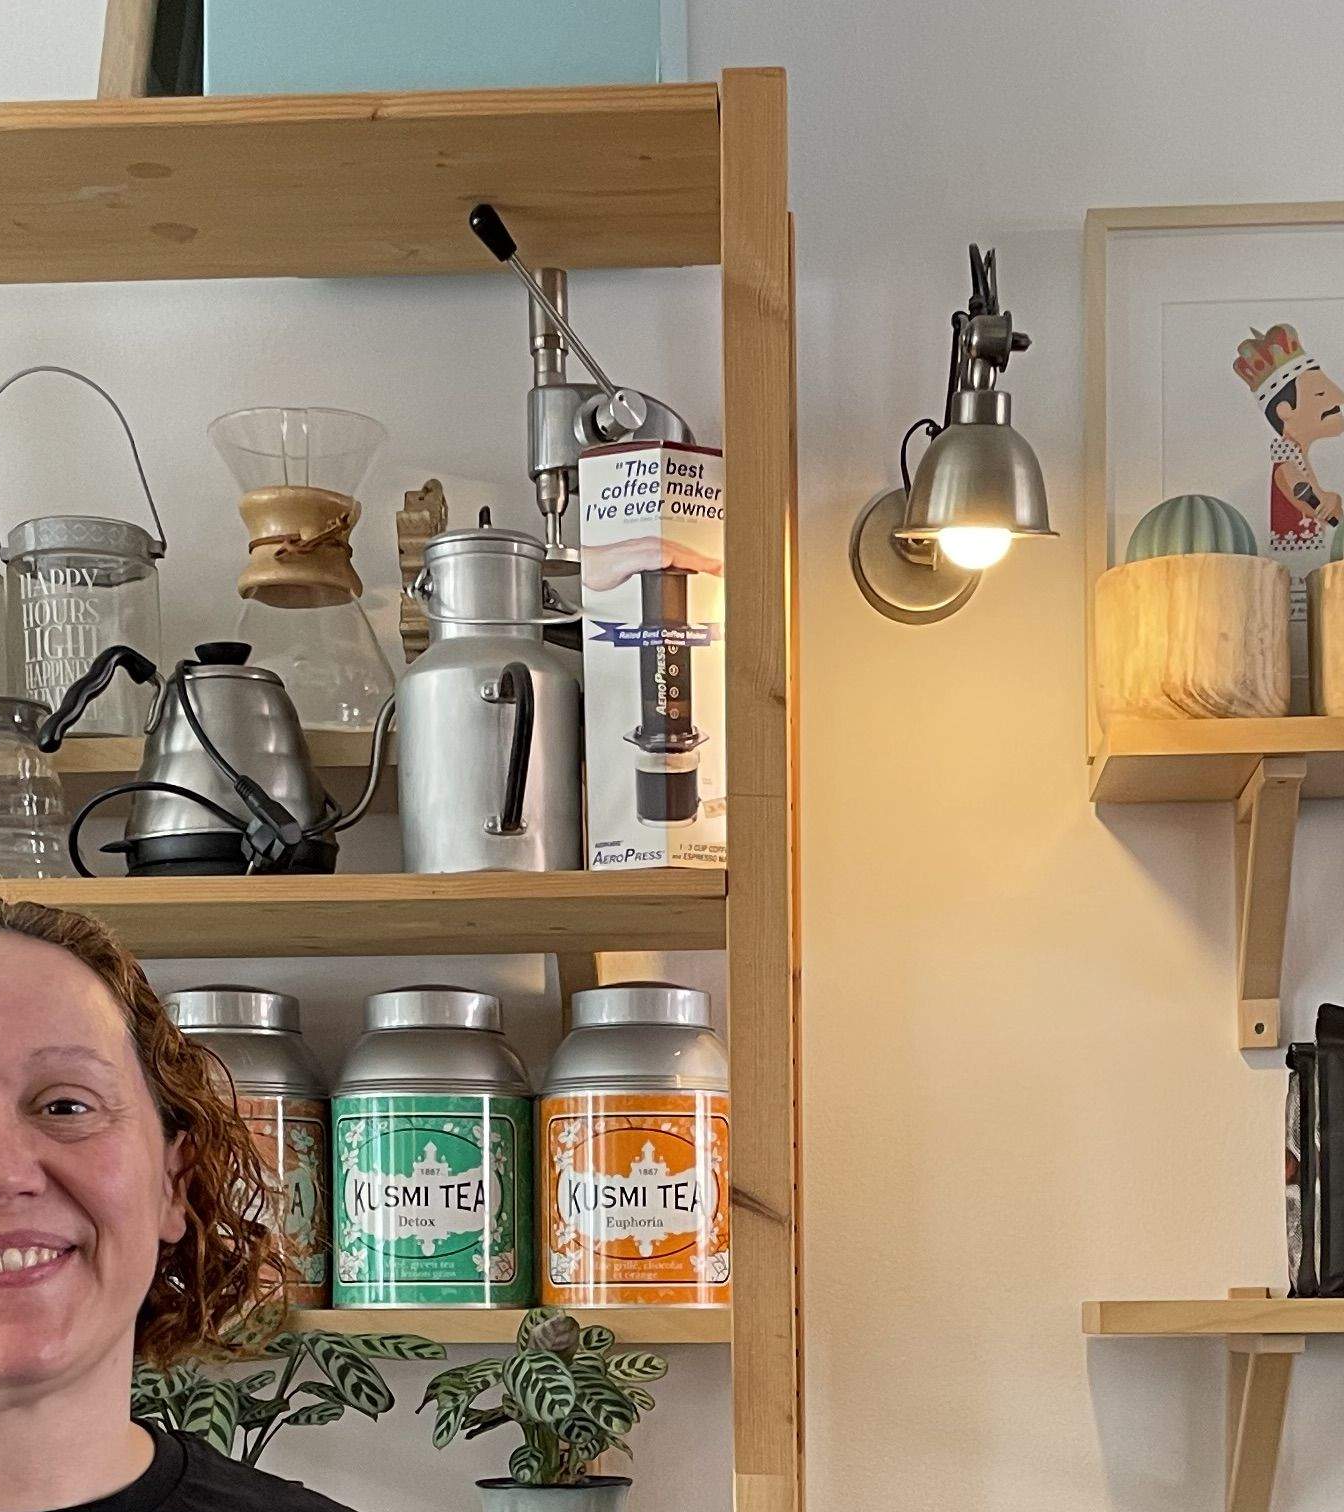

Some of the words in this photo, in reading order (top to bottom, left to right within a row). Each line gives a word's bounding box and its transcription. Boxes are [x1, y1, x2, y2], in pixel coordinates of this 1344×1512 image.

[666, 457, 704, 479] best
[601, 479, 660, 500] coffee
[667, 481, 722, 500] maker
[586, 504, 617, 521] I've
[624, 500, 665, 516] ever
[19, 568, 98, 599] HAPPY
[22, 598, 100, 629] HOURS
[24, 624, 100, 663] LIGHT
[354, 1178, 430, 1217] KUSMI
[439, 1179, 487, 1214] TEA
[568, 1179, 646, 1218] KUSMI
[657, 1181, 707, 1217] TEA
[399, 1215, 436, 1228] Detox
[607, 1216, 664, 1231] Euphoria
